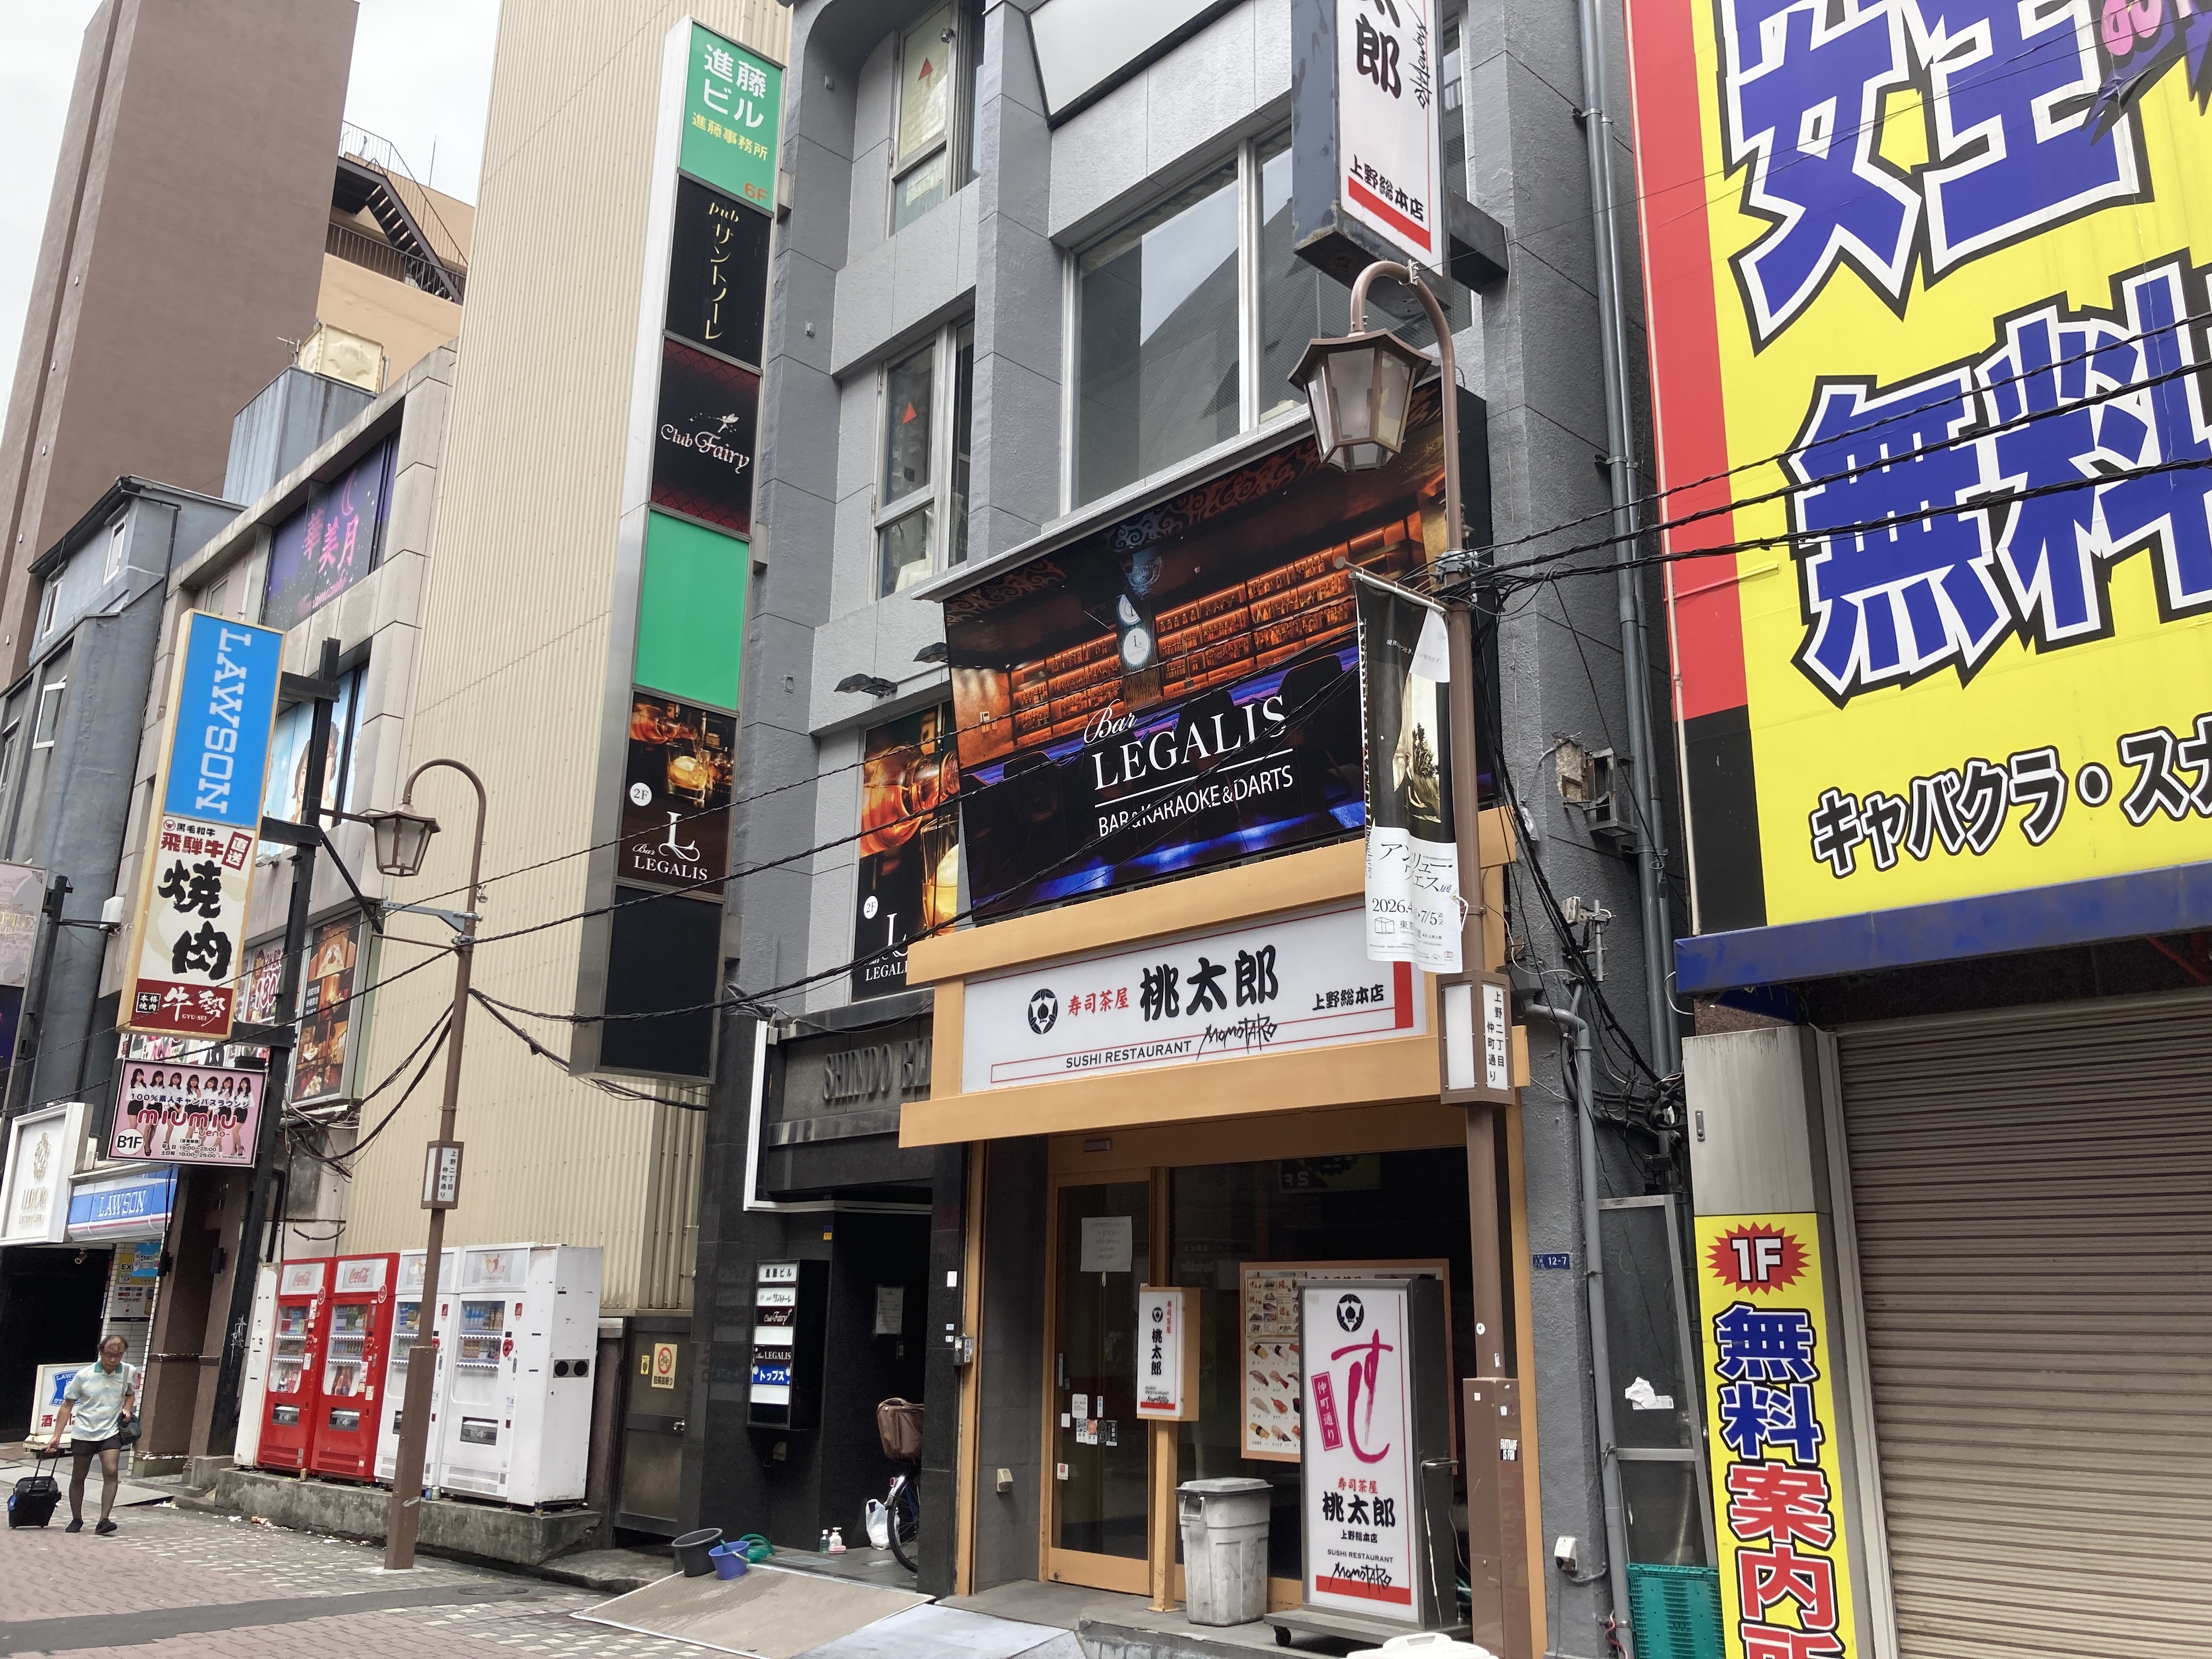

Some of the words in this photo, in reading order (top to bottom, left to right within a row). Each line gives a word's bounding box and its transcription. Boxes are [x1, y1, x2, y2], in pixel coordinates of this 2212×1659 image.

[1356, 0, 1401, 99] 郎
[704, 44, 767, 99] 進藤
[704, 78, 764, 128] ビル
[692, 112, 768, 161] 進藤事務所
[744, 182, 768, 202] 6F
[1350, 154, 1424, 222] 上野総本店
[708, 201, 739, 223] pub
[705, 223, 733, 340] サントノーレ
[661, 424, 693, 448] Club
[695, 431, 749, 474] Fairy
[195, 628, 252, 814] LAWSON
[1084, 699, 1137, 743] Bar
[1092, 695, 1286, 791] LEGALIS
[634, 789, 648, 800] 2F
[177, 823, 216, 837] 黒毛和牛
[161, 832, 223, 859] 飛騨牛
[225, 836, 248, 866] 直送
[632, 843, 656, 855] Bar
[1378, 843, 1453, 873] アンリュー・
[634, 855, 708, 881] LEGALIS
[158, 859, 233, 980] 焼肉
[866, 902, 876, 913] 2F
[866, 961, 908, 981] LEGALI
[1067, 987, 1129, 1017] 寿司茶屋
[1139, 945, 1278, 1022] 桃太郎
[139, 1002, 157, 1011] 焼肉
[140, 994, 159, 1003] 本格
[1312, 984, 1384, 1011] 上野総本店
[1494, 991, 1504, 1067] 上野二丁目
[1066, 1053, 1102, 1069] SUSHI
[1105, 1040, 1192, 1064] RESTAURANT
[1487, 1022, 1496, 1081] 仲町通り
[116, 1135, 143, 1149] B1F
[440, 1167, 448, 1198] 仲町通り
[447, 1150, 457, 1190] 上野二丁目
[98, 1189, 147, 1217] LAWSON
[1548, 1256, 1566, 1266] 12-7
[1731, 1237, 1783, 1283] 1F
[764, 1351, 791, 1361] LEGALIS
[1152, 1328, 1163, 1375] 桃太郎
[760, 1370, 785, 1381] トップス
[1317, 1381, 1335, 1444] 仲町通り
[1338, 1477, 1378, 1494] 寿司茶屋
[1322, 1491, 1396, 1528] 桃太郎
[1341, 1530, 1378, 1544] 上野総本店
[1327, 1549, 1347, 1557] SUSHI
[1348, 1551, 1393, 1564] RESTAURANT
